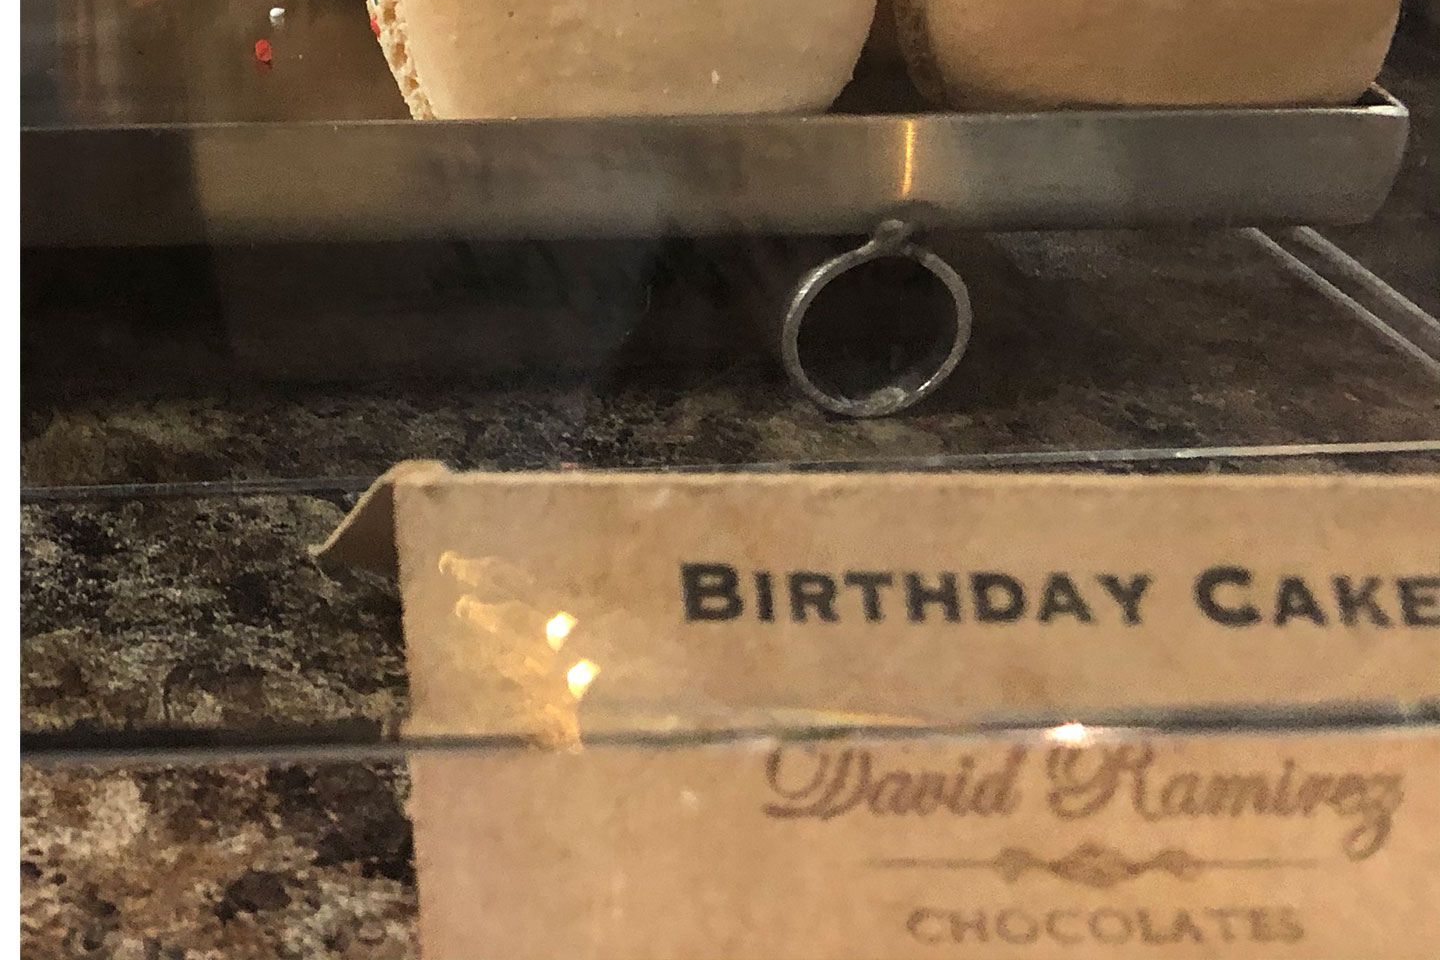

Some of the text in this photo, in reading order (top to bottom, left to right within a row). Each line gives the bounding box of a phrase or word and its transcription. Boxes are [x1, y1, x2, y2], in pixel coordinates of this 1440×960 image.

[680, 561, 1440, 628] BIRTHDAY CAKE
[761, 740, 1404, 860] David Ramirez
[906, 905, 1304, 944] CHOCOLATES
